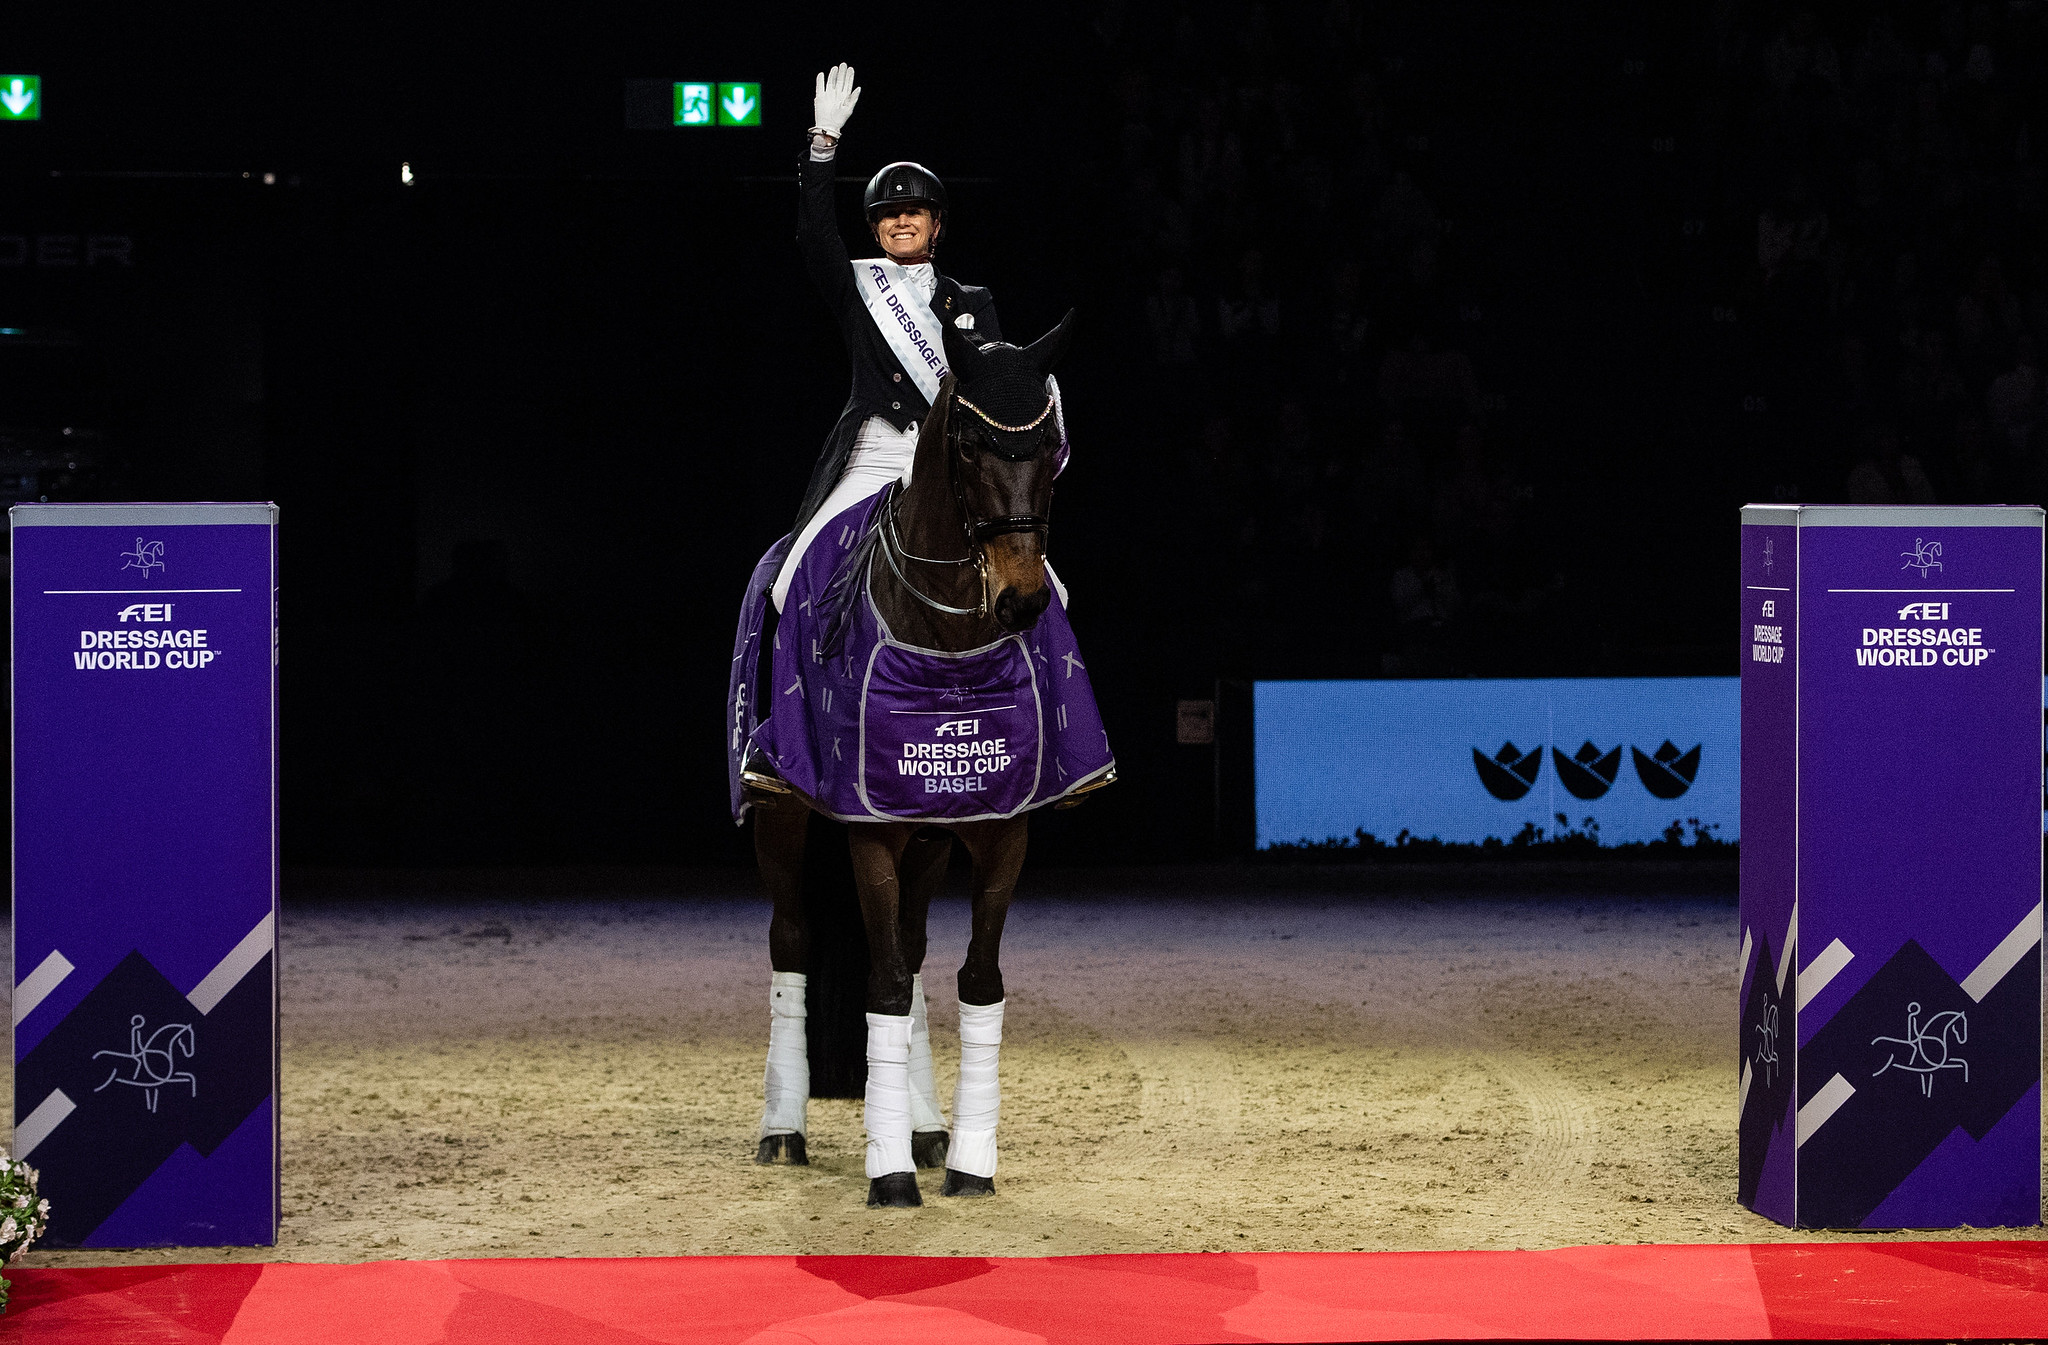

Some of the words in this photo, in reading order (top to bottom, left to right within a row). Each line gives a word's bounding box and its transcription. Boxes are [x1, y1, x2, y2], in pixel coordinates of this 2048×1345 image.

[886, 293, 942, 370] DRESSAGE
[81, 630, 207, 649] DRESSAGE
[1754, 625, 1782, 643] DRESSAGE
[1863, 628, 1982, 646] DRESSAGE
[74, 651, 160, 670] WORLD
[1752, 644, 1772, 662] WORLD
[1856, 649, 1937, 666] WORLD
[903, 738, 1006, 759] DRESSAGE
[898, 759, 970, 776] WORLD
[925, 776, 987, 793] BASEL
